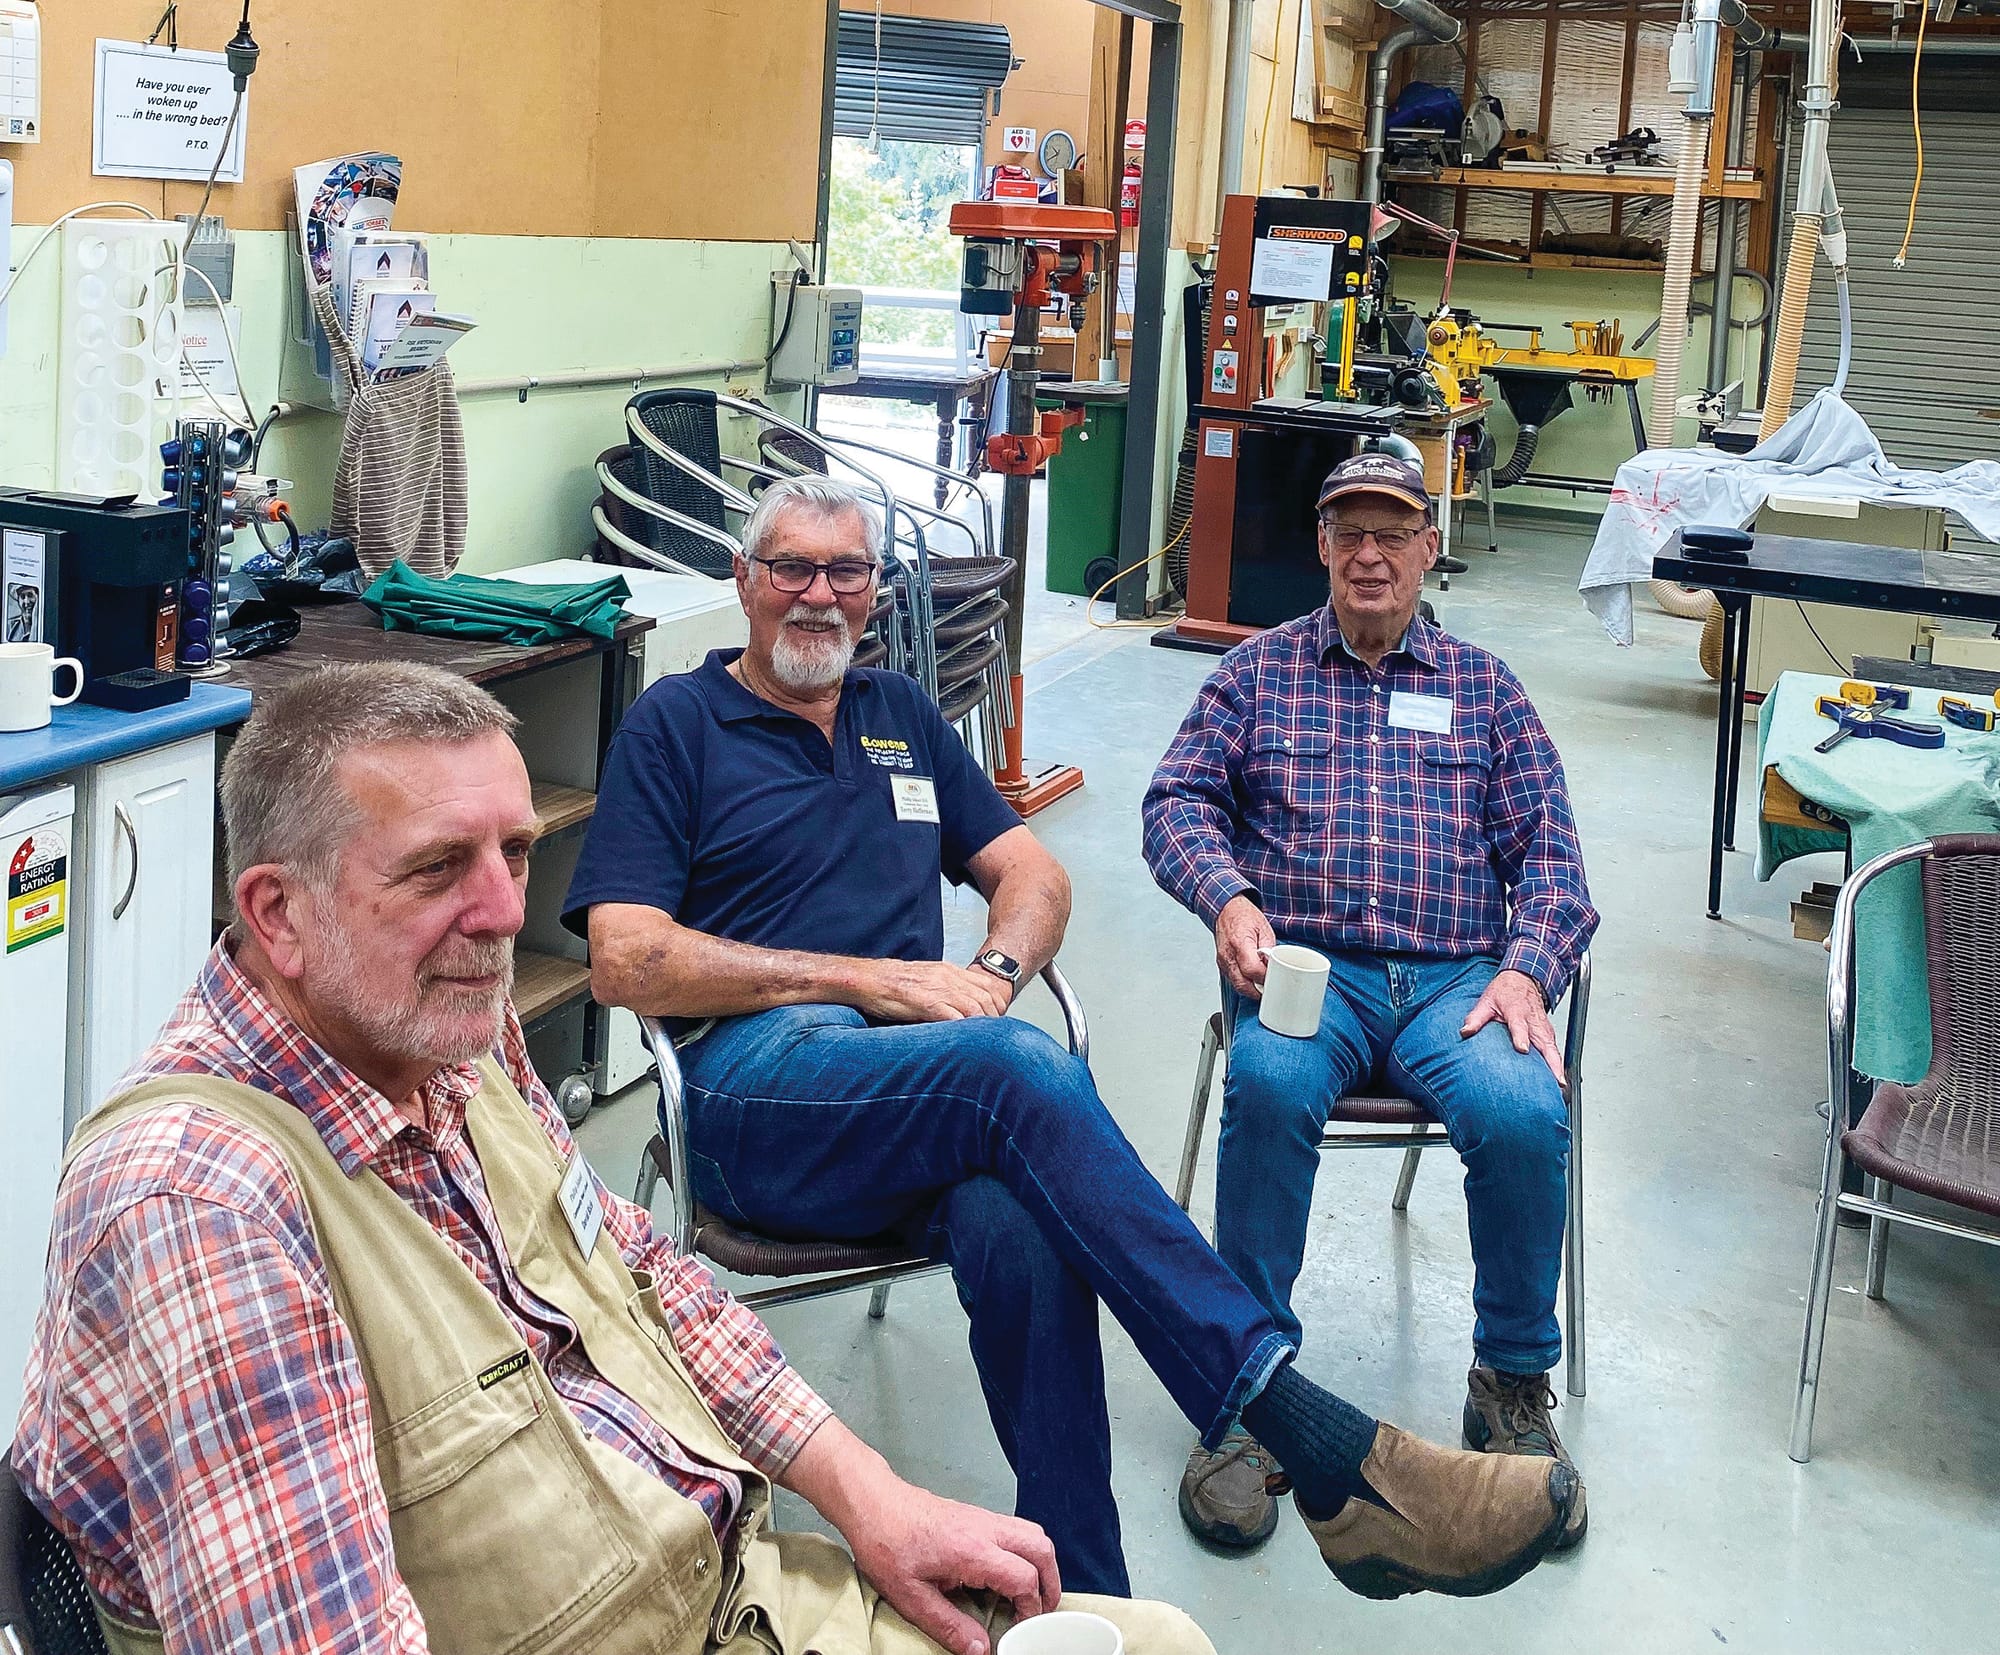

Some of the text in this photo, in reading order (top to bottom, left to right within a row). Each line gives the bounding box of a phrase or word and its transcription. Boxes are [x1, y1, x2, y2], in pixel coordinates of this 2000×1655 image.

[135, 77, 211, 95] Have you ever
[147, 96, 198, 111] woken up
[133, 108, 143, 119] in
[145, 110, 162, 121] the
[165, 115, 198, 126] wrong
[200, 114, 228, 127] bed?
[185, 140, 209, 150] P.T.O.
[1272, 228, 1344, 240] SHERWOOD
[20, 861, 56, 883] ENERGY
[20, 873, 55, 893] RATING
